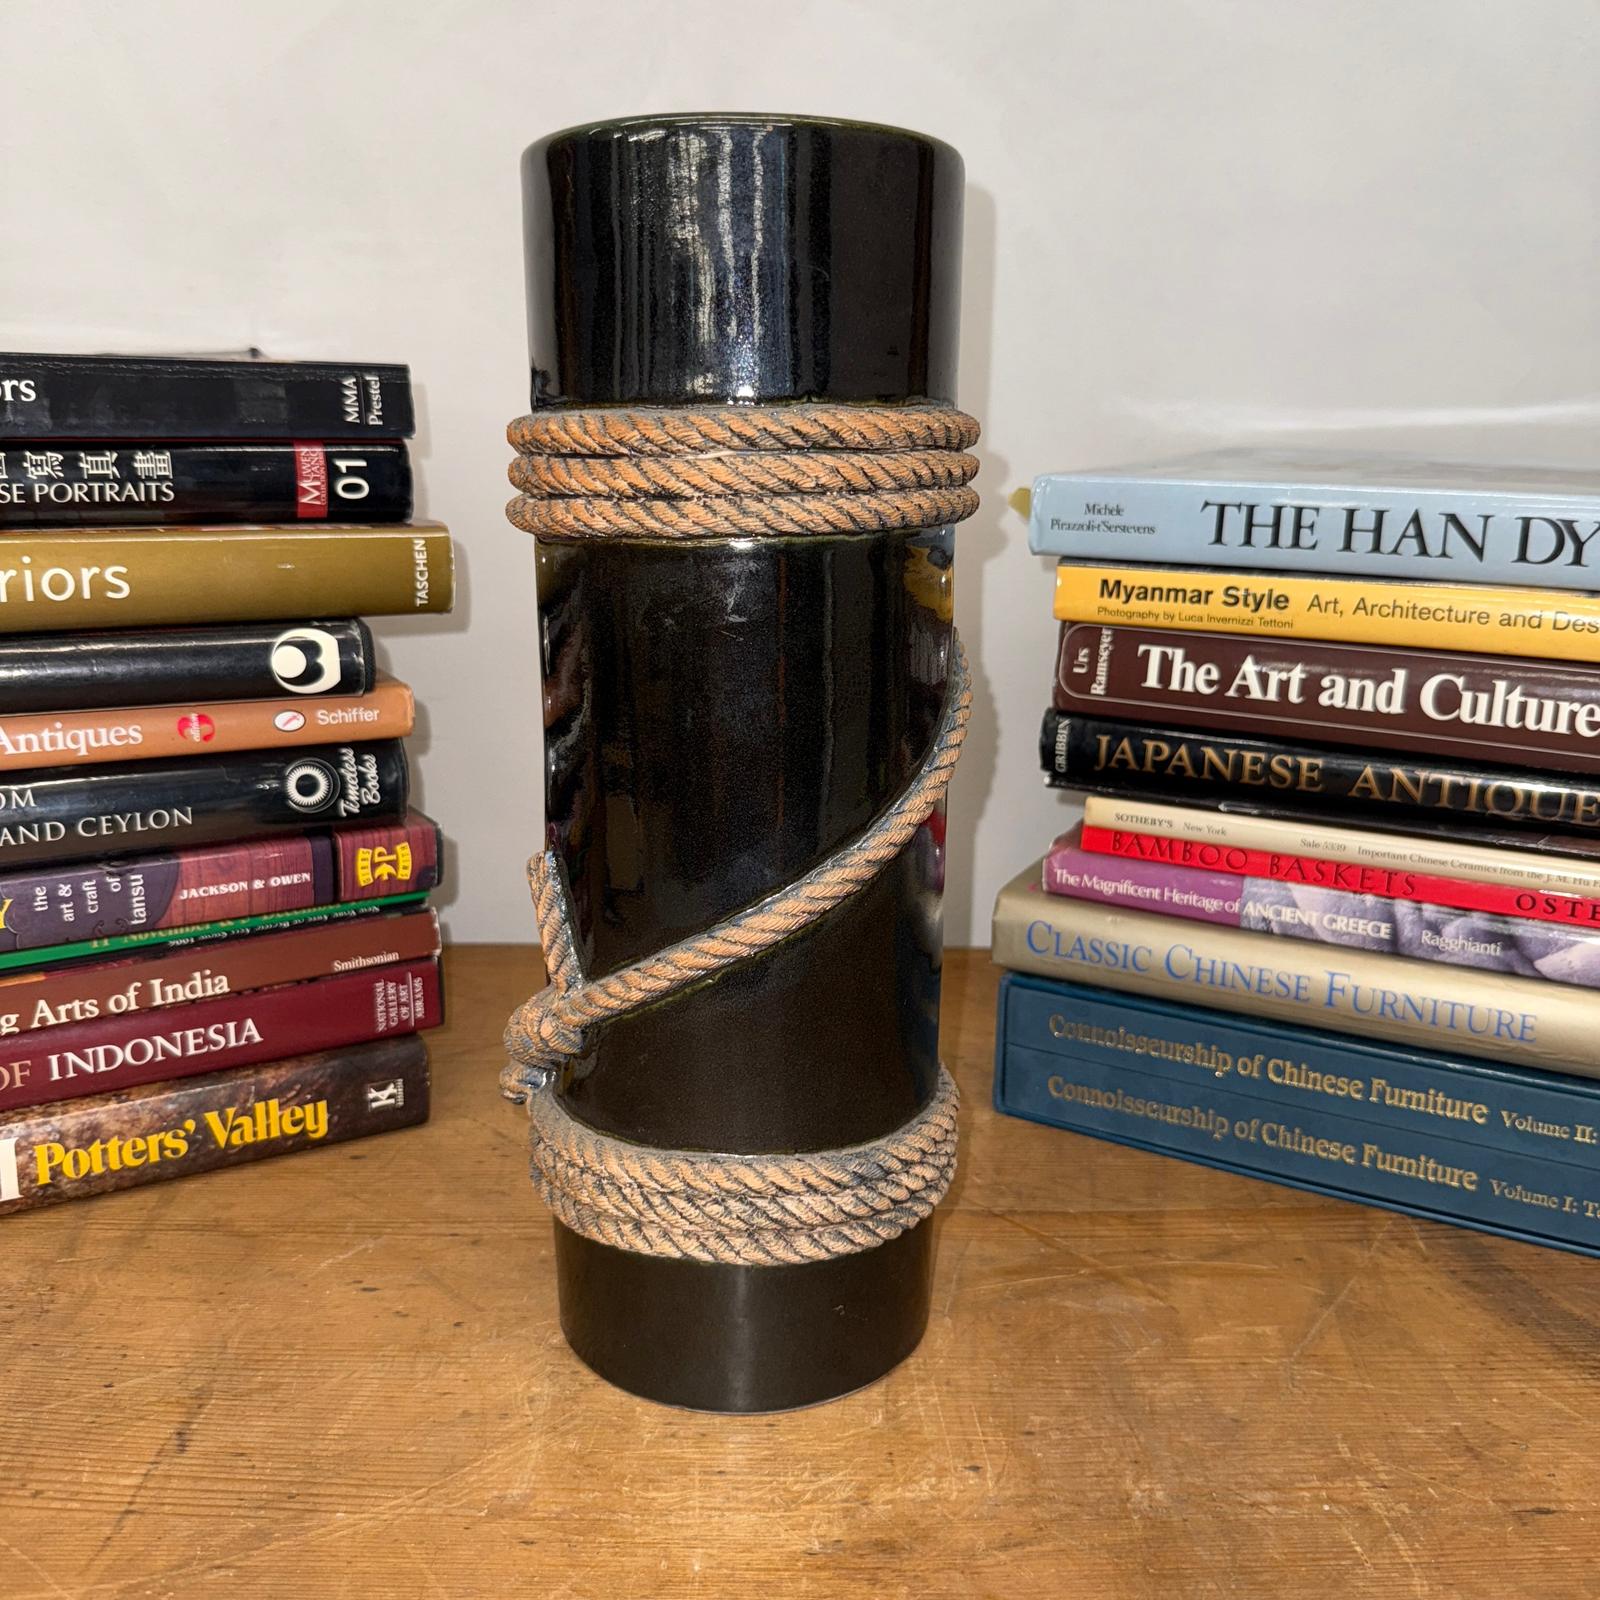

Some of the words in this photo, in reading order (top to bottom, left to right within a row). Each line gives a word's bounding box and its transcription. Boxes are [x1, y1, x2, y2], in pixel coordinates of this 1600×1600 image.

[0, 379, 37, 402] rs
[342, 376, 360, 423] MMA
[364, 373, 384, 426] Prestel
[33, 482, 175, 503] PORTRAITS
[334, 459, 370, 499] 01
[1200, 500, 1320, 550] THE
[1336, 508, 1494, 563] HAN
[1511, 516, 1600, 567] DY
[414, 539, 426, 607] TASCHEN
[1097, 607, 1159, 622] Photography
[1163, 610, 1175, 622] by
[1178, 612, 1203, 624] Luca
[1207, 614, 1253, 626] Invernizzi
[1257, 617, 1294, 629] Tettoni
[1100, 579, 1213, 605] Myanmar
[1222, 586, 1289, 613] Style
[1307, 594, 1343, 618] Art,
[1353, 597, 1490, 625] Architecture
[1499, 610, 1542, 629] and
[1553, 611, 1600, 634] Des
[1073, 647, 1090, 674] Urs
[1090, 627, 1114, 695] Ramseyer
[317, 708, 380, 726] Schiffer
[1137, 644, 1220, 695] The
[1225, 654, 1306, 704] Art
[1318, 668, 1406, 715] and
[1420, 673, 1600, 739] Culture
[0, 722, 143, 756] Antiques
[1055, 717, 1072, 773] GRIBBIN
[337, 746, 361, 818] Timeless
[358, 753, 381, 805] Books
[1093, 735, 1325, 793] JAPANESE
[1348, 764, 1600, 828] ANTIQUE
[0, 821, 65, 846] AND
[77, 806, 193, 838] CEYLON
[1114, 813, 1173, 828] SOTHEBY'S
[1183, 822, 1203, 833] New
[1206, 825, 1227, 836] York
[1300, 838, 1320, 848] Sale
[1358, 846, 1407, 864] Important
[1409, 853, 1448, 867] Chinese
[1450, 859, 1498, 874] Ceramics
[1500, 866, 1524, 878] from
[1526, 870, 1542, 881] the
[106, 877, 122, 892] of
[179, 880, 249, 900] JACKSON
[253, 879, 265, 889] &
[271, 872, 311, 888] OWEN
[1111, 831, 1248, 870] BAMBOO
[1269, 854, 1416, 896] BASKETS
[33, 886, 49, 911] the
[58, 884, 73, 897] &
[60, 901, 75, 922] art
[82, 880, 99, 913] craft
[130, 874, 147, 925] tansu
[1054, 868, 1079, 887] The
[1081, 873, 1161, 900] Magnificent
[1164, 887, 1223, 913] Heritage
[1224, 898, 1241, 913] of
[1243, 900, 1319, 928] ANCIENT
[1323, 914, 1393, 940] GREECE
[1421, 929, 1502, 956] Ragghianti
[333, 951, 399, 972] Smithsonian
[1026, 920, 1152, 973] CLASSIC
[1164, 944, 1310, 1002] CHINESE
[1324, 970, 1538, 1043] FURNITURE
[31, 999, 99, 1028] Arts
[108, 982, 141, 1014] of
[150, 969, 231, 1007] India
[375, 979, 387, 1032] NATIONAL
[386, 981, 398, 1027] GALLERY
[48, 1018, 263, 1082] INDONESIA
[1049, 1014, 1233, 1078] Connoisseurship
[1237, 1054, 1264, 1079] of
[1267, 1057, 1365, 1100] Chinese
[1369, 1077, 1490, 1125] Furniture
[1500, 1110, 1571, 1139] Volume
[1573, 1123, 1598, 1144] II:
[33, 1119, 197, 1187] Potters'
[205, 1099, 329, 1149] Valley
[1048, 1075, 1229, 1140] Connoisseurship
[1234, 1117, 1262, 1141] of
[1261, 1122, 1357, 1166] Chinese
[1361, 1143, 1479, 1192] Furniture
[1489, 1178, 1558, 1209] Volume
